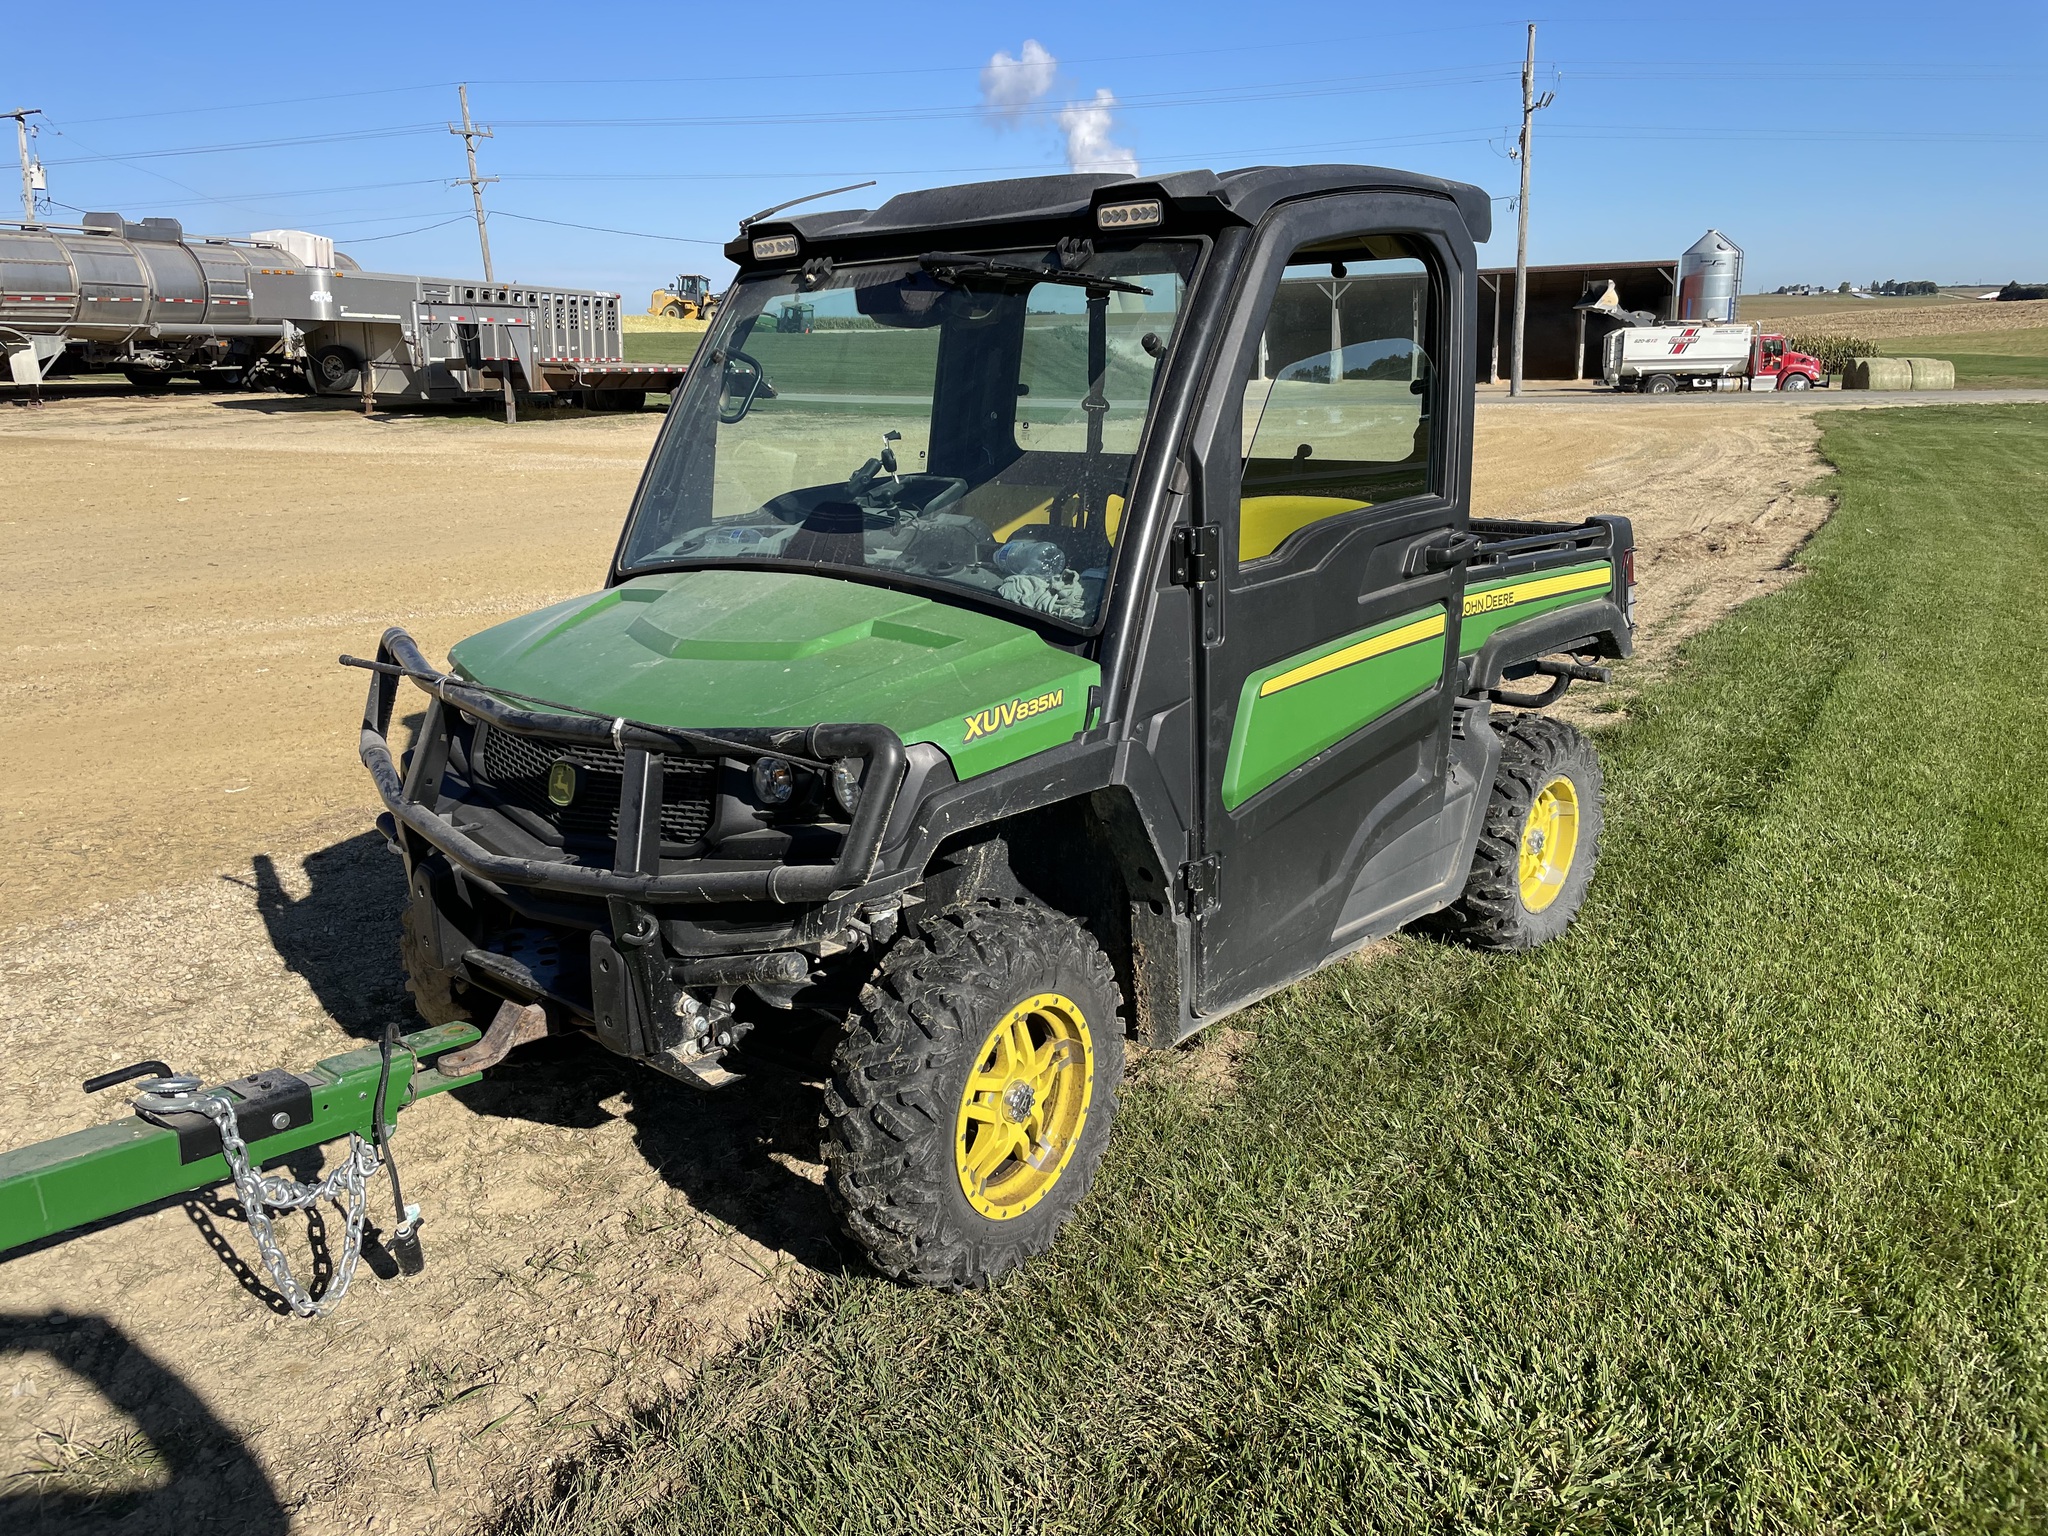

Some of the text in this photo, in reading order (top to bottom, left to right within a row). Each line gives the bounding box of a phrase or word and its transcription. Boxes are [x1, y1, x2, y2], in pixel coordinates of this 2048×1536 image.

[1462, 592, 1515, 615] OHN DEERE
[963, 688, 1063, 743] XUV835M
